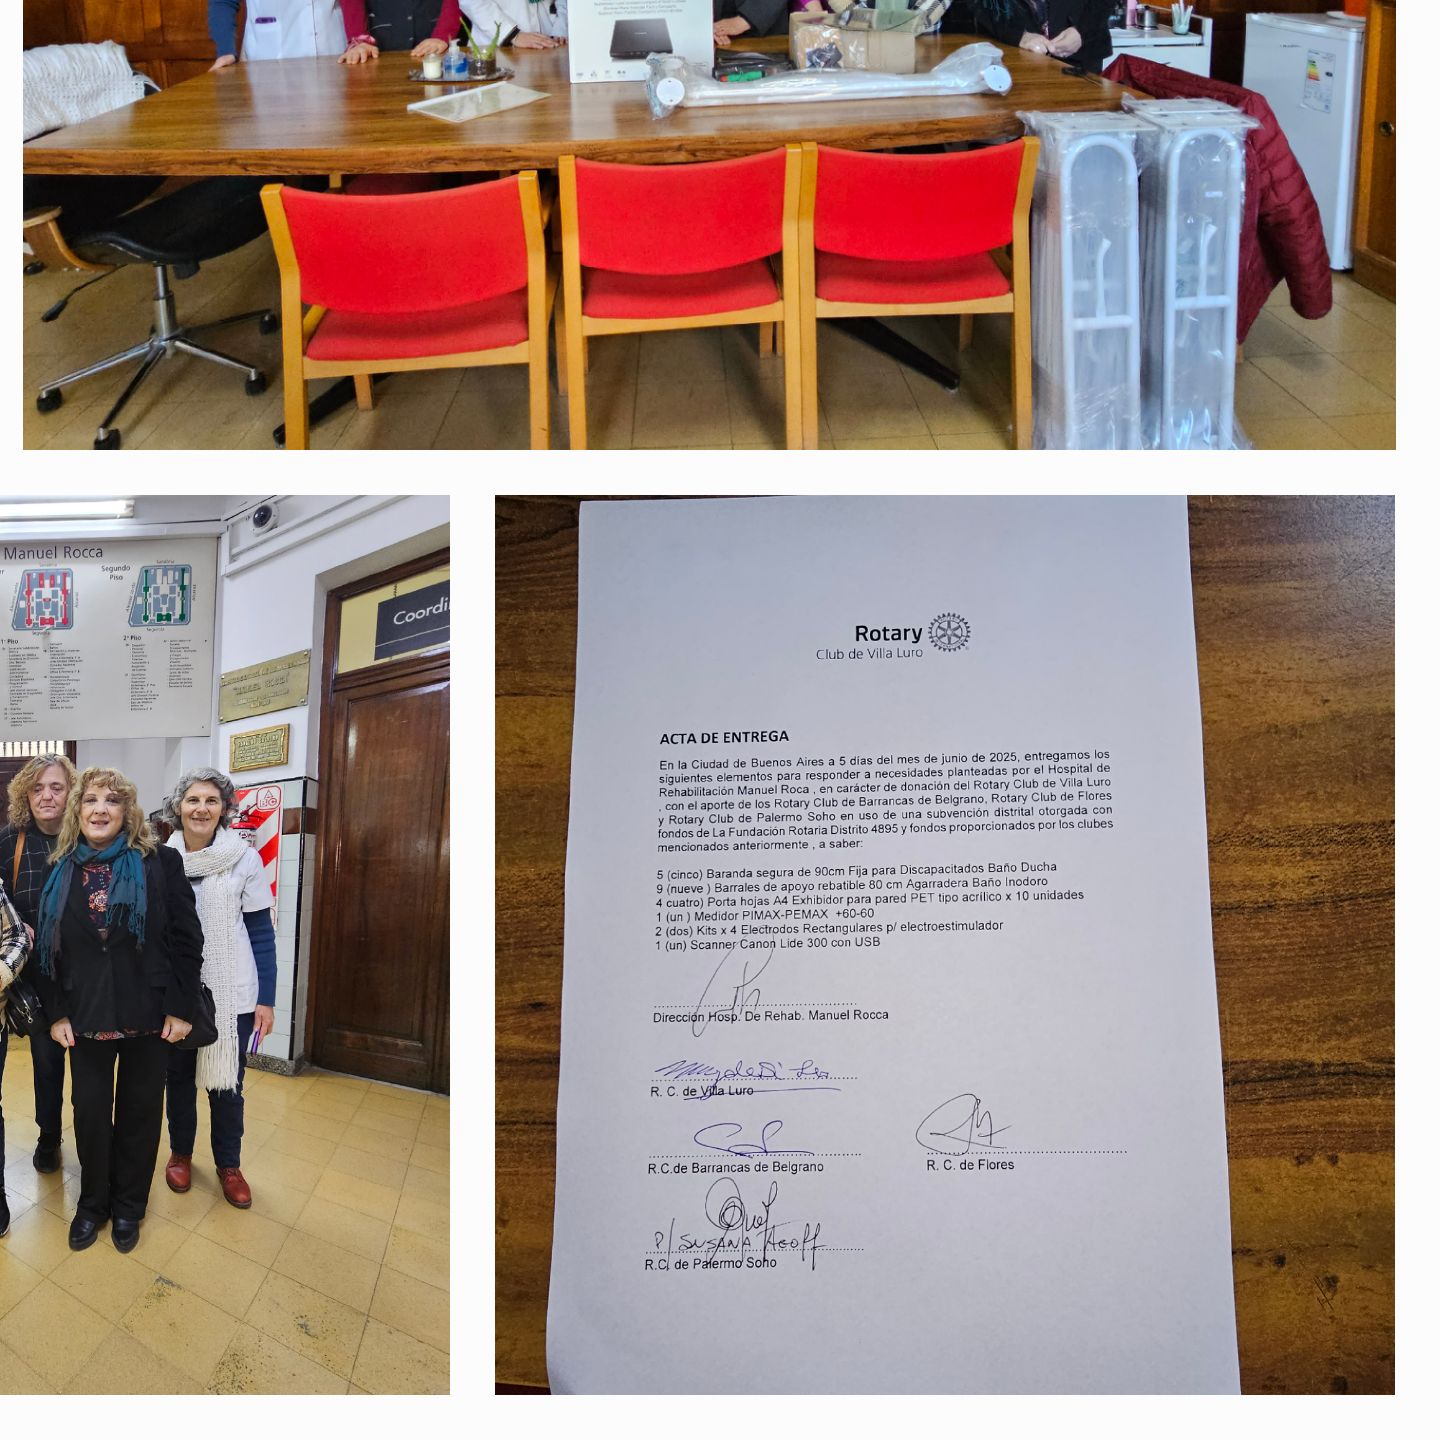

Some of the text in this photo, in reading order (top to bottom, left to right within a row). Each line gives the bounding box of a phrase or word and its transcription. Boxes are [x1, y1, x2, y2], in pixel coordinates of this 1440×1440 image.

[4, 546, 57, 560] Manuel
[63, 546, 103, 559] Rocca
[101, 565, 131, 573] Segundo
[393, 596, 450, 625] Coordi
[855, 626, 923, 643] Rotary
[816, 648, 923, 660] Club de Villa Luro
[660, 730, 789, 744] ACTA DE ENTREGA
[660, 749, 1110, 770] En la Ciudad de Buenos Aires a 5 días del mes de junio de 2025, entregamos los
[659, 776, 1111, 797] Rehabilitación Manuel Roca en carácter de donación del Rotary Club de Villa Luro
[657, 861, 1056, 881] 5 (cinco) Baranda segura de 90cm Fija para Discapacitados Baño Ducha
[657, 884, 663, 894] 9
[715, 882, 760, 893] Barrales
[764, 881, 777, 892] de
[781, 883, 814, 893] apoyo
[818, 879, 865, 890] rebatible
[869, 879, 882, 889] 80
[886, 881, 902, 889] cm
[906, 877, 968, 891] Agarradera
[973, 877, 1001, 887] Baño
[1006, 876, 1048, 886] Inodoro
[656, 889, 1084, 910] 4 cuatro) Porta hojas A4 Exhibidor para pared PET tipo acrílico x 10 unidades
[657, 912, 660, 922] 1
[695, 911, 739, 921] Medidor
[743, 909, 828, 920] PIMAX-PEMAX
[836, 908, 874, 919] +60-60
[655, 920, 1004, 938] 2 (dos) Kits x 4 Electrodos Rectangulares p/ electroestimulador
[656, 936, 880, 952] 1 (un) Scanner Canon Lide 300 con USB
[654, 1009, 888, 1024] Dirección Hosp. De Rehab. Manuel Rocca
[651, 1086, 754, 1096] R. C. de Villa Luro
[692, 1162, 750, 1172] Barrancas
[754, 1162, 768, 1172] de
[773, 1162, 824, 1174] Belgrano
[927, 1160, 1014, 1170] R. C. de Flores
[645, 1259, 776, 1269] R.C. de Palermo Soho
